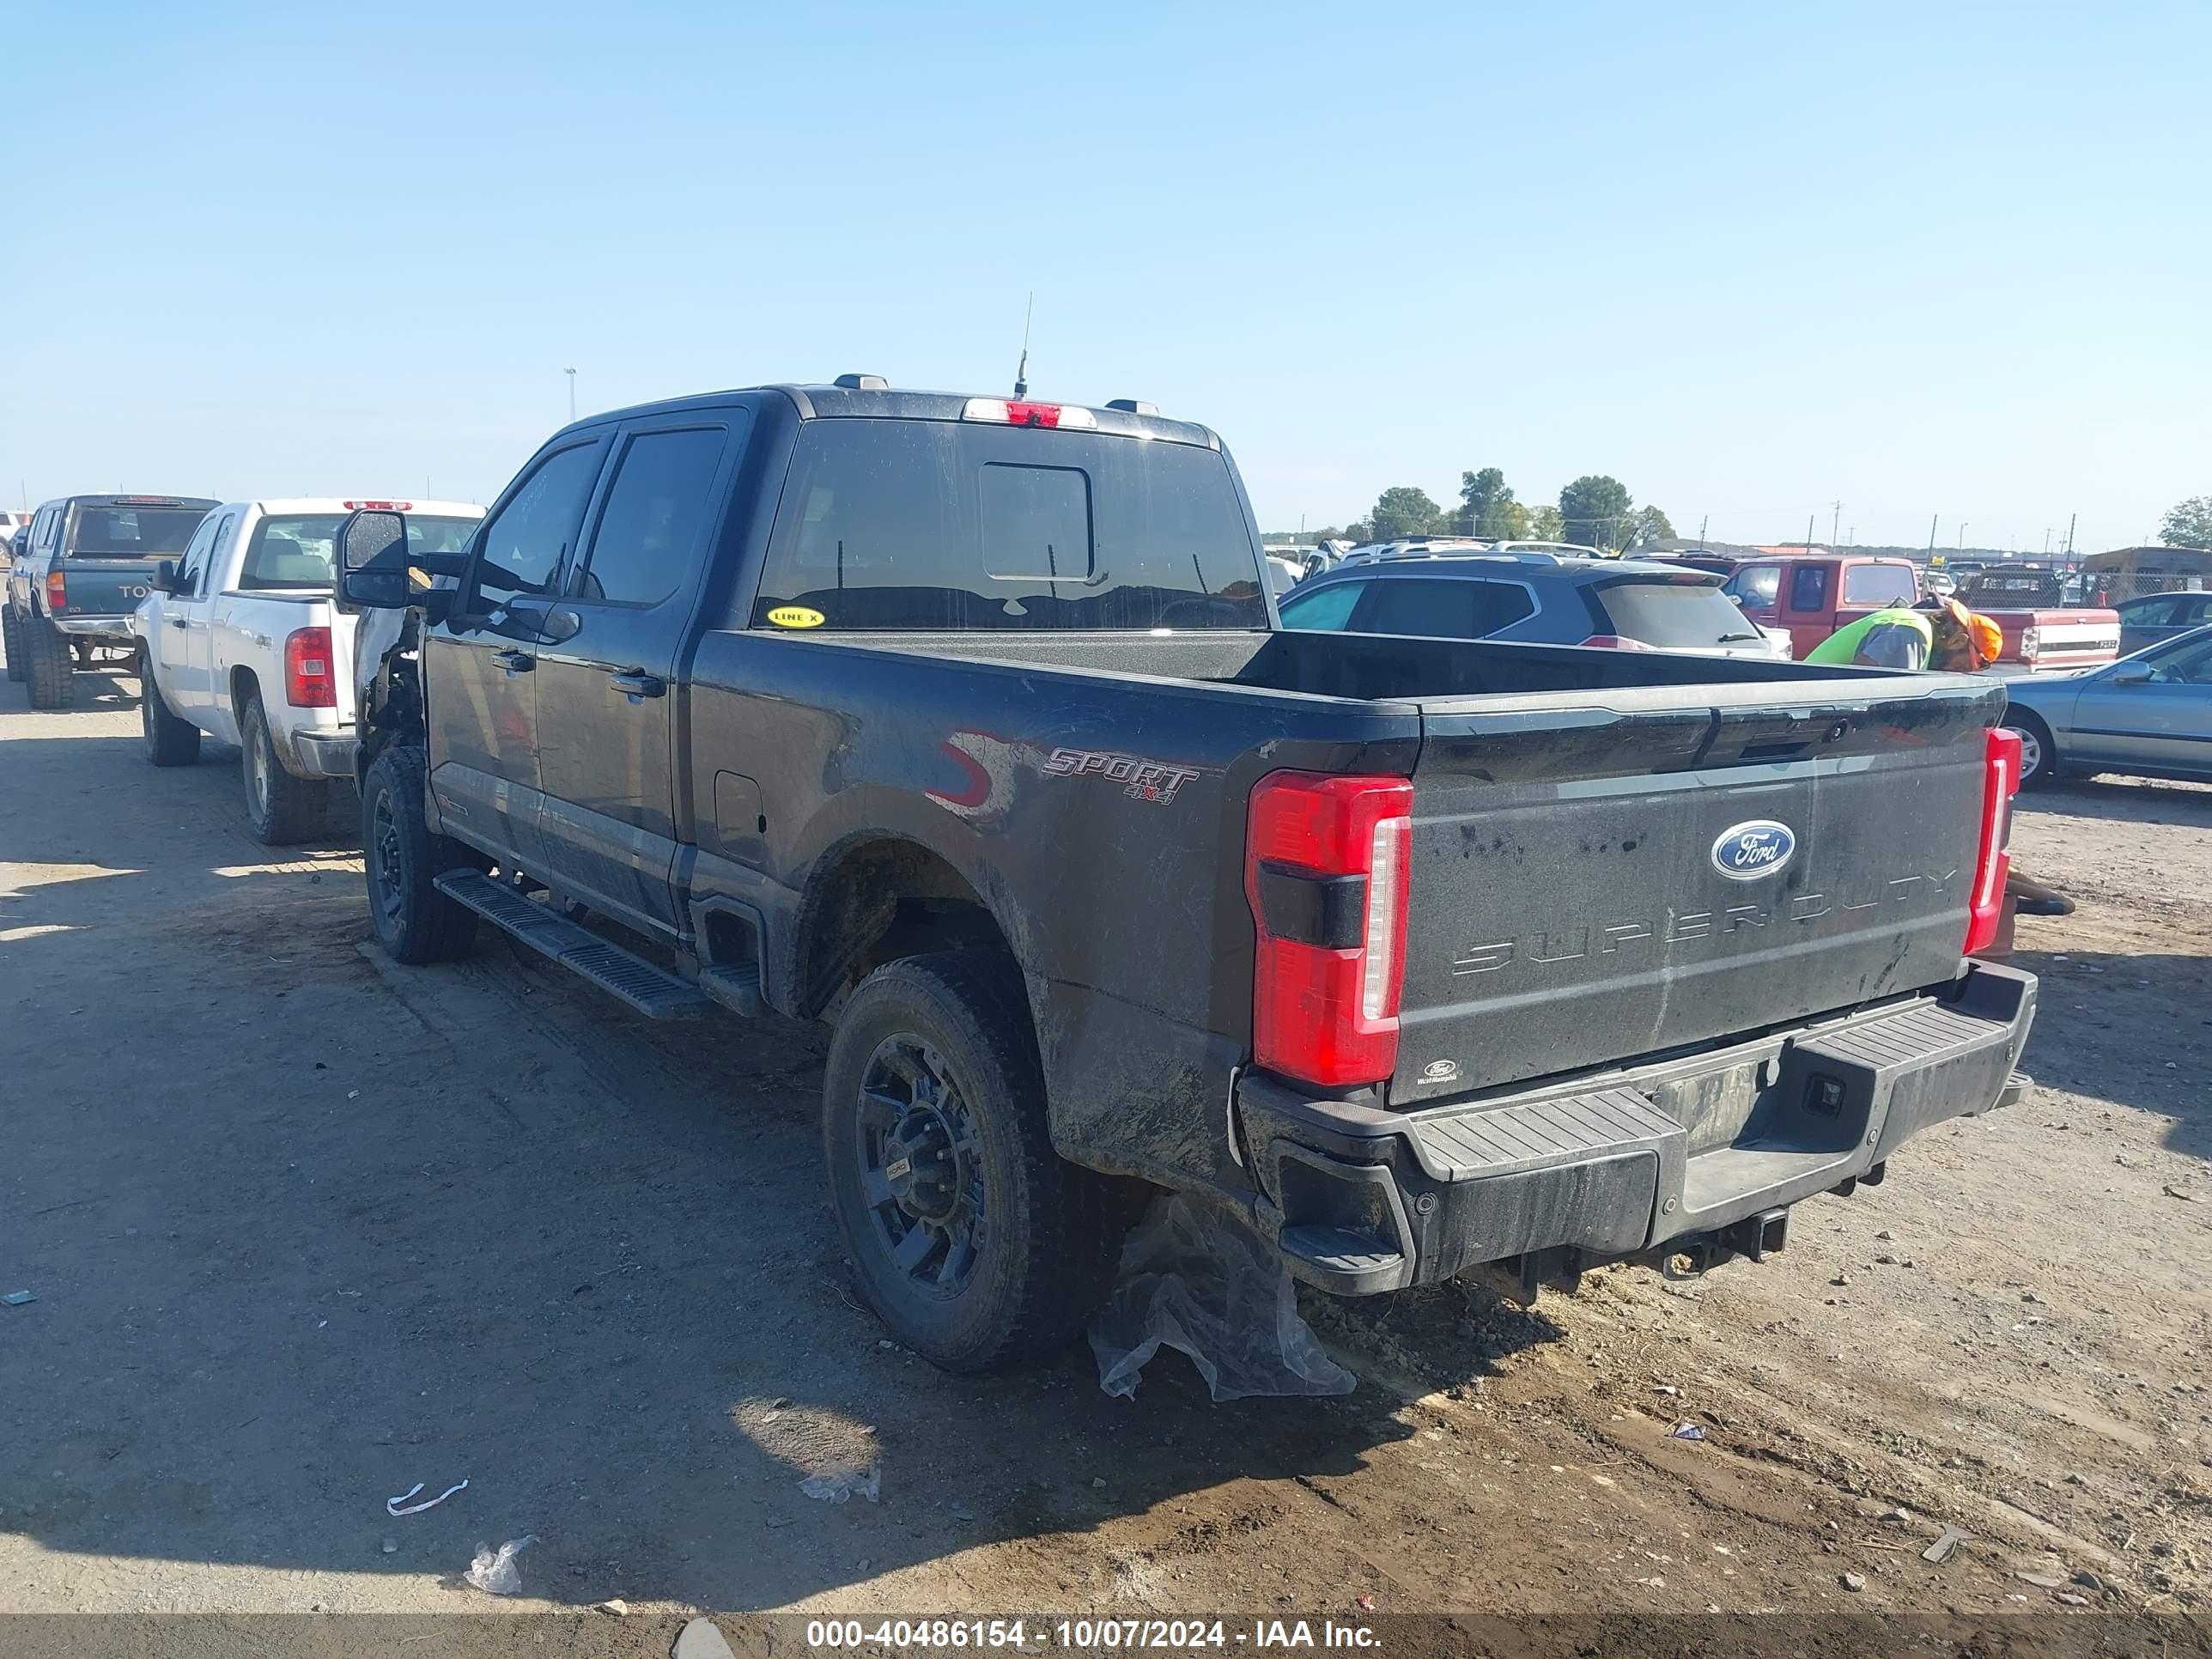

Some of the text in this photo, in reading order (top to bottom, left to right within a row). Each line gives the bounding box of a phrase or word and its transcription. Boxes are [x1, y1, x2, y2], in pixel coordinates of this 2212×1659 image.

[1042, 748, 1200, 793] SPORT
[1734, 833, 1780, 866] Ford
[1451, 869, 1959, 975] SUPER DUTY
[1430, 1063, 1451, 1074] Ford
